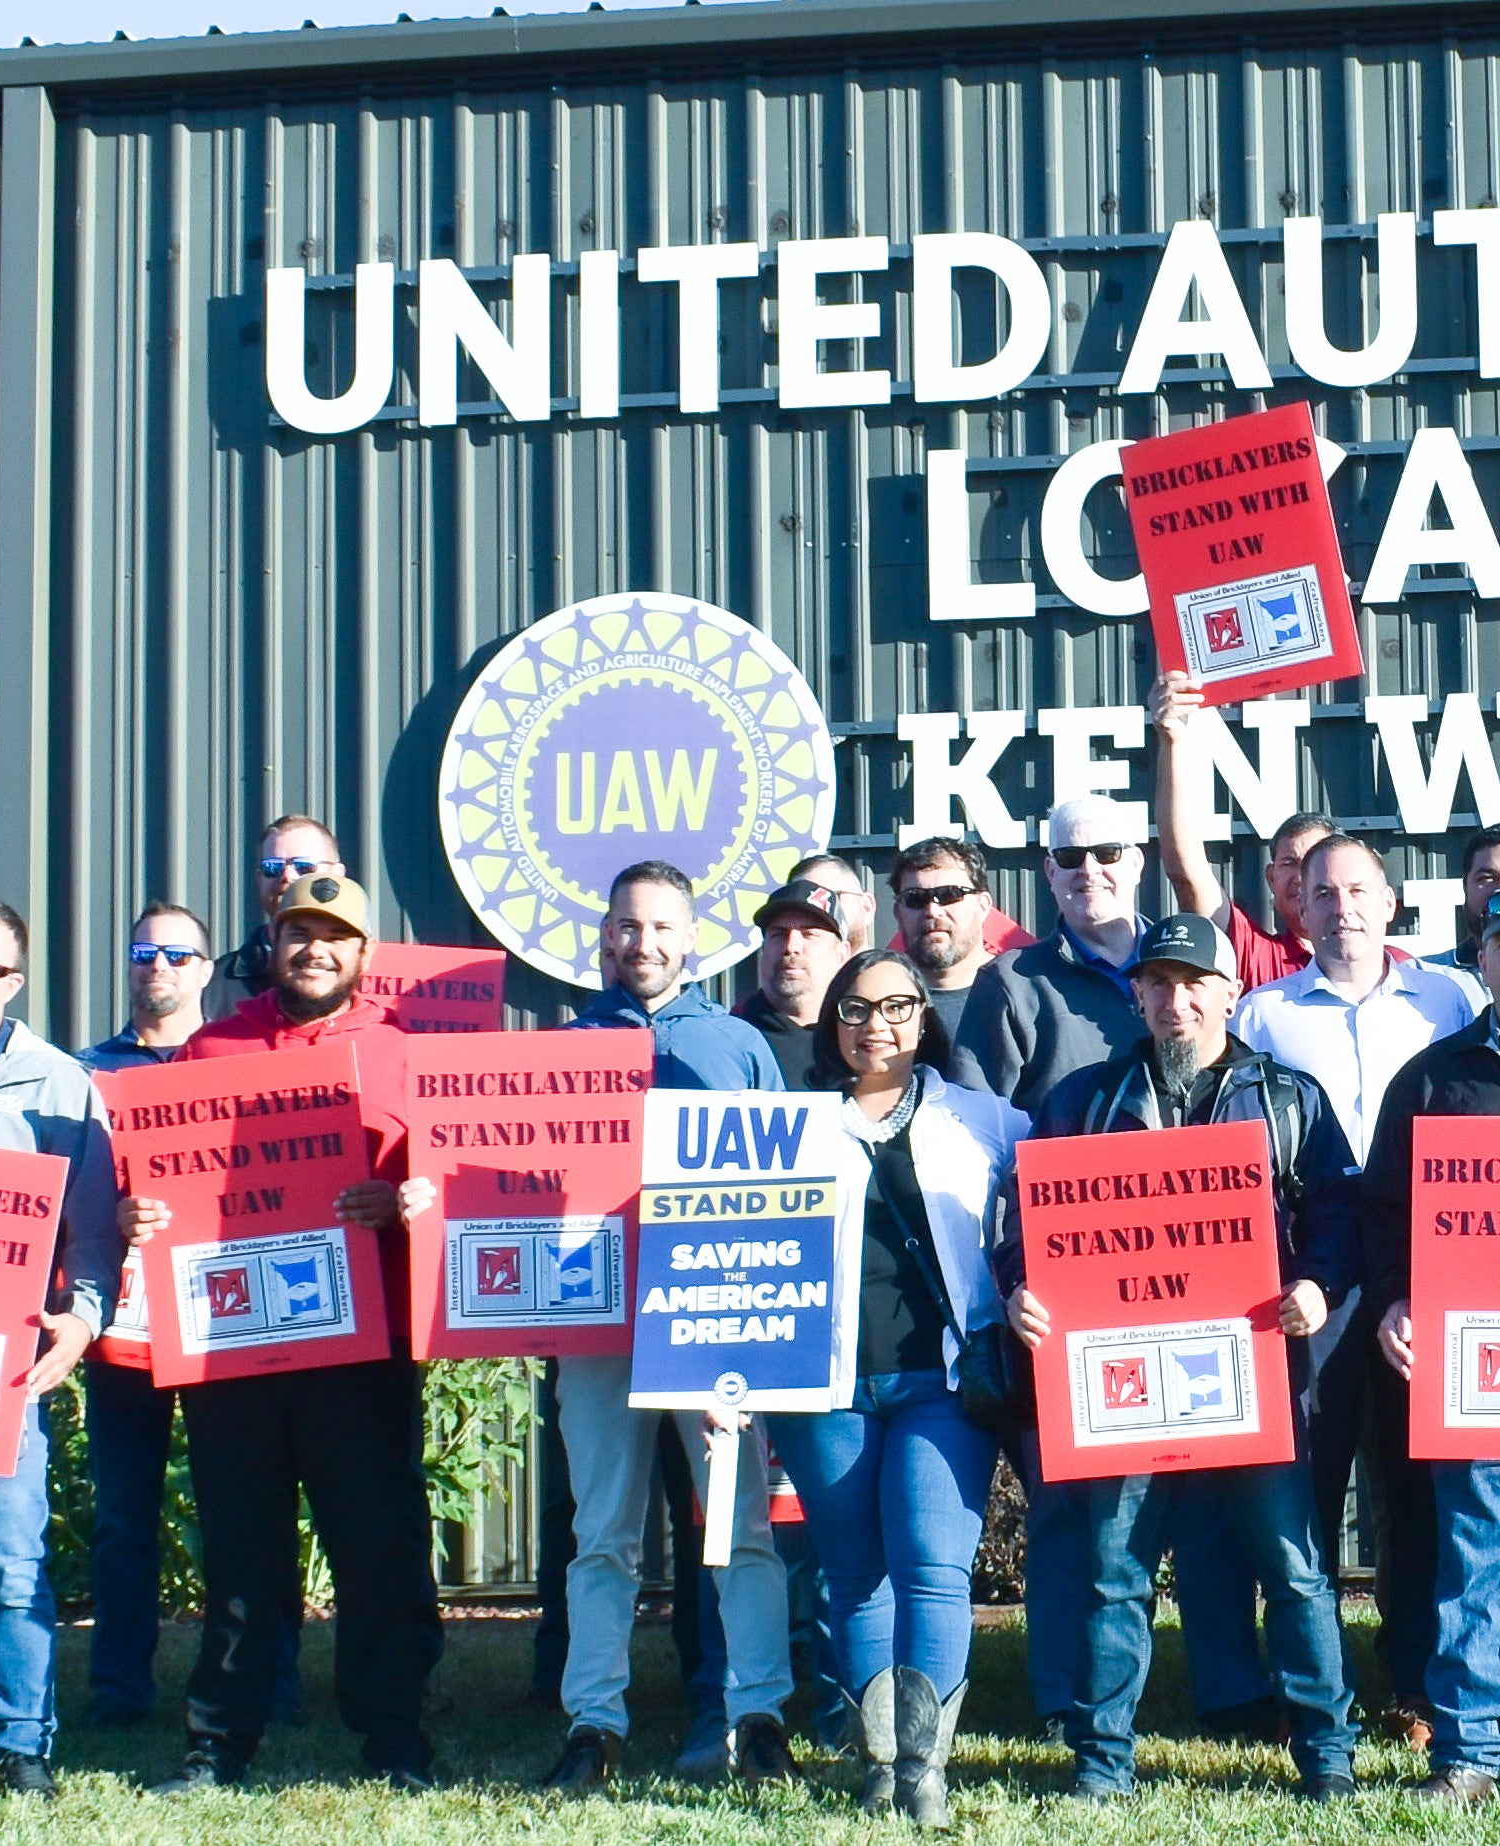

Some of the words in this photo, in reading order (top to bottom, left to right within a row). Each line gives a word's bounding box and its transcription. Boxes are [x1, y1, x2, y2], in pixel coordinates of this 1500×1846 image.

[266, 229, 1052, 435] UNITED
[1131, 437, 1312, 498] BRICKLAYERS
[1149, 500, 1233, 537] STAND
[1238, 481, 1310, 516] WITH
[1208, 533, 1265, 565] UAW
[1190, 592, 1213, 601] Union
[1222, 581, 1263, 594] Bricklayers
[1265, 576, 1279, 585] and
[1280, 571, 1301, 582] Allied
[1309, 582, 1326, 643] Craftworkers
[1181, 610, 1197, 670] International
[568, 662, 600, 686] AND
[604, 653, 702, 681] AGRICULTURE
[510, 680, 567, 755] AEROSPACE
[703, 673, 763, 741] IMPLEMENT
[556, 749, 718, 835] UAW
[755, 741, 773, 816] WORKERS
[898, 700, 1311, 850] KEN
[500, 755, 524, 852] AUTOMOBILE
[753, 821, 767, 843] OF
[517, 856, 560, 902] UNITED
[707, 842, 757, 900] AMERICA
[358, 976, 495, 1002] CKLAYERS
[416, 1069, 645, 1099] BRICKLAYERS
[131, 1081, 351, 1132] BRICKLAYERS
[149, 1143, 252, 1179] STAND
[257, 1132, 344, 1164] WITH
[429, 1121, 535, 1149] STAND
[544, 1118, 632, 1145] WITH
[677, 1107, 809, 1170] UAW
[217, 1186, 285, 1218] UAW
[497, 1168, 569, 1195] UAW
[652, 1191, 768, 1218] STAND
[780, 1189, 825, 1212] UP
[1029, 1162, 1263, 1209] BRICKLAYERS
[670, 1239, 802, 1271] SAVING
[1046, 1225, 1155, 1259] STAND
[1163, 1216, 1254, 1249] WITH
[640, 1280, 827, 1314] AMERICAN
[723, 1271, 747, 1283] THE
[1116, 1272, 1191, 1303] UAW
[670, 1314, 796, 1346] DREAM
[1466, 1315, 1494, 1324] Union
[1450, 1333, 1458, 1407] International
